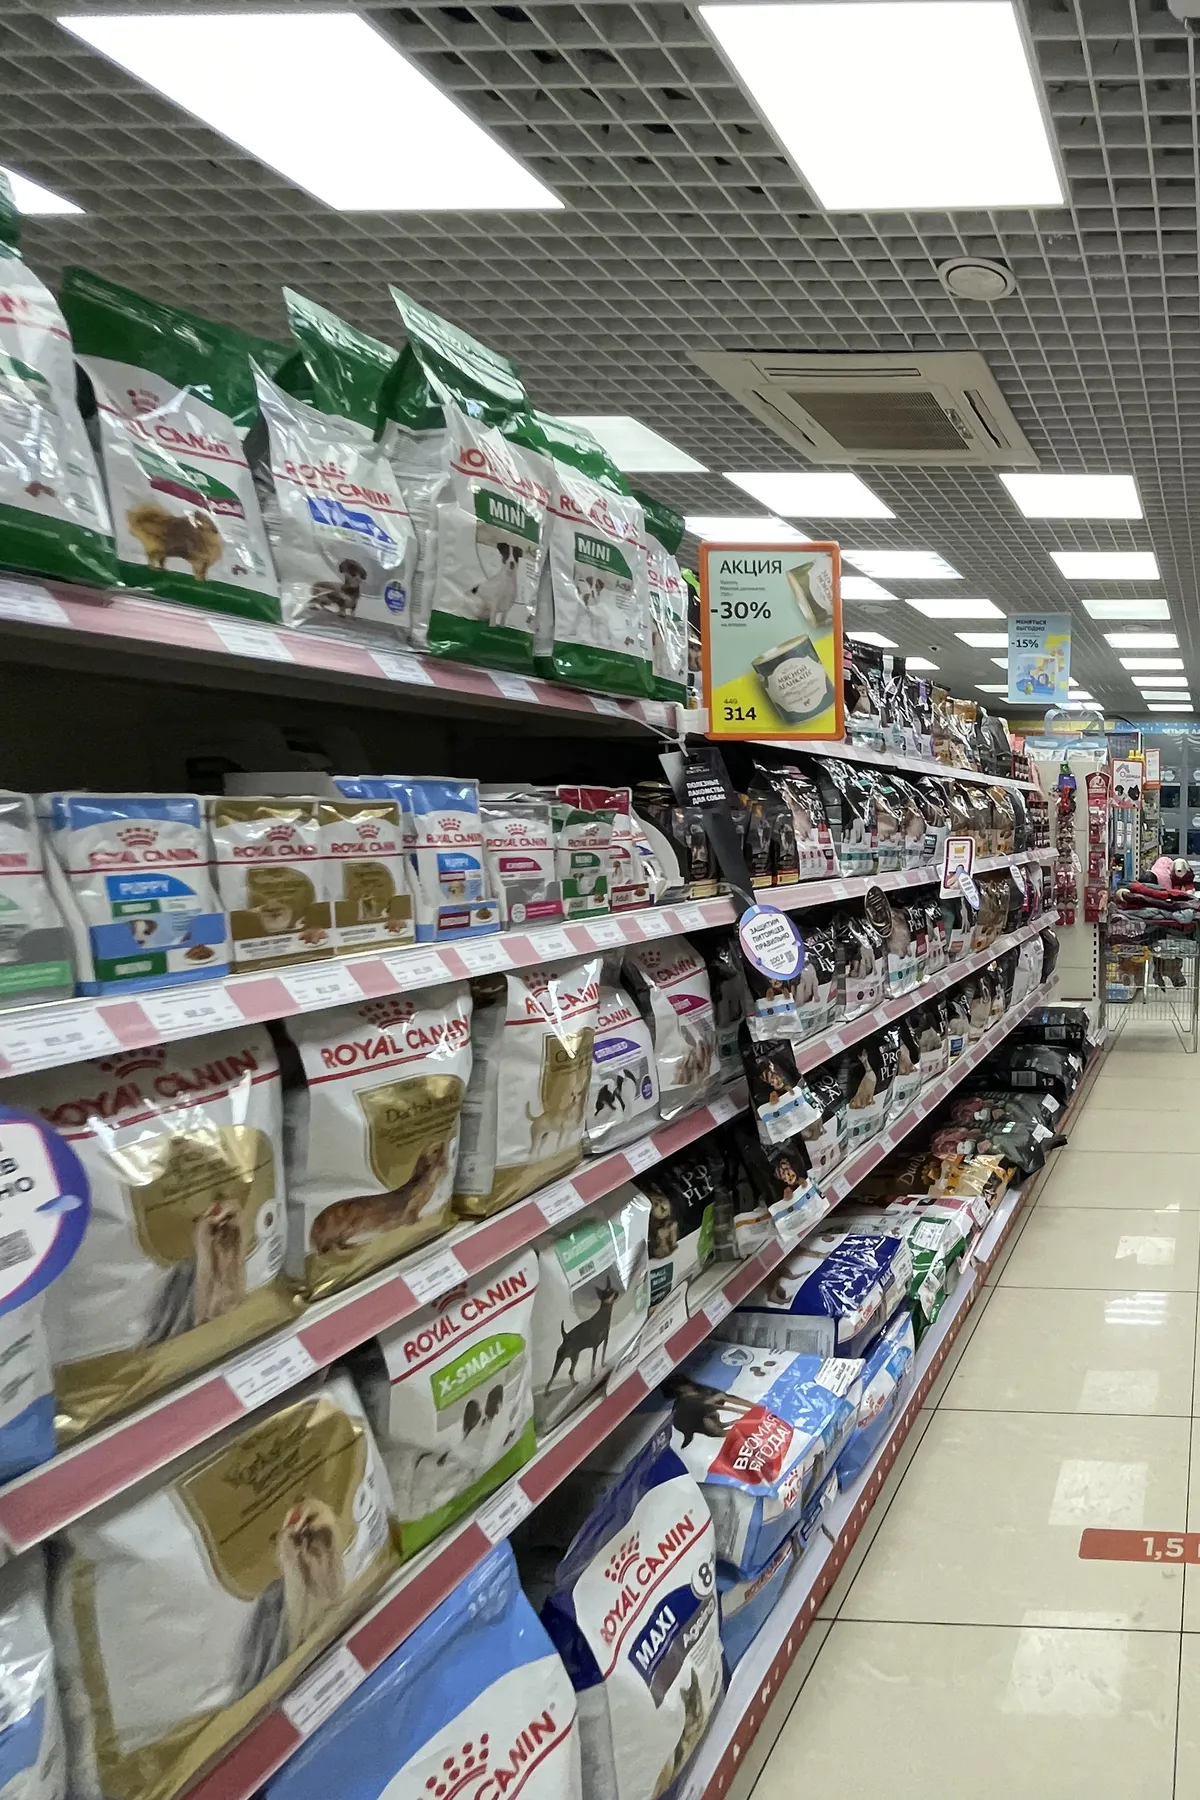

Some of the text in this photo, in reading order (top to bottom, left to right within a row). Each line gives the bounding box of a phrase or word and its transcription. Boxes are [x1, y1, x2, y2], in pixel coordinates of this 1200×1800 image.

[336, 482, 392, 506] CANIN
[488, 497, 526, 529] MINI
[577, 536, 611, 562] MINI
[719, 559, 782, 577] АКЦИЯ
[710, 601, 772, 619] -30%
[1011, 639, 1039, 648] -15%
[723, 706, 758, 721] 314
[688, 786, 726, 797] ЛАКОМСТВА
[486, 838, 518, 848] ROYAL
[749, 918, 780, 935] ЗАЩИТИМ
[752, 925, 785, 943] ПИТОМЦЕВ
[755, 932, 790, 951] ПРАВИЛЬНО
[597, 1008, 632, 1027] CANIN
[1070, 1031, 1081, 1039] 12
[320, 1031, 403, 1069] ROYAL
[403, 1271, 527, 1364] ROYAL CANIN
[438, 1341, 506, 1396] X-SMALL
[1142, 1536, 1184, 1561] 1,5
[600, 1514, 695, 1646] ROYAL CANIN
[635, 1604, 677, 1671] MAXI
